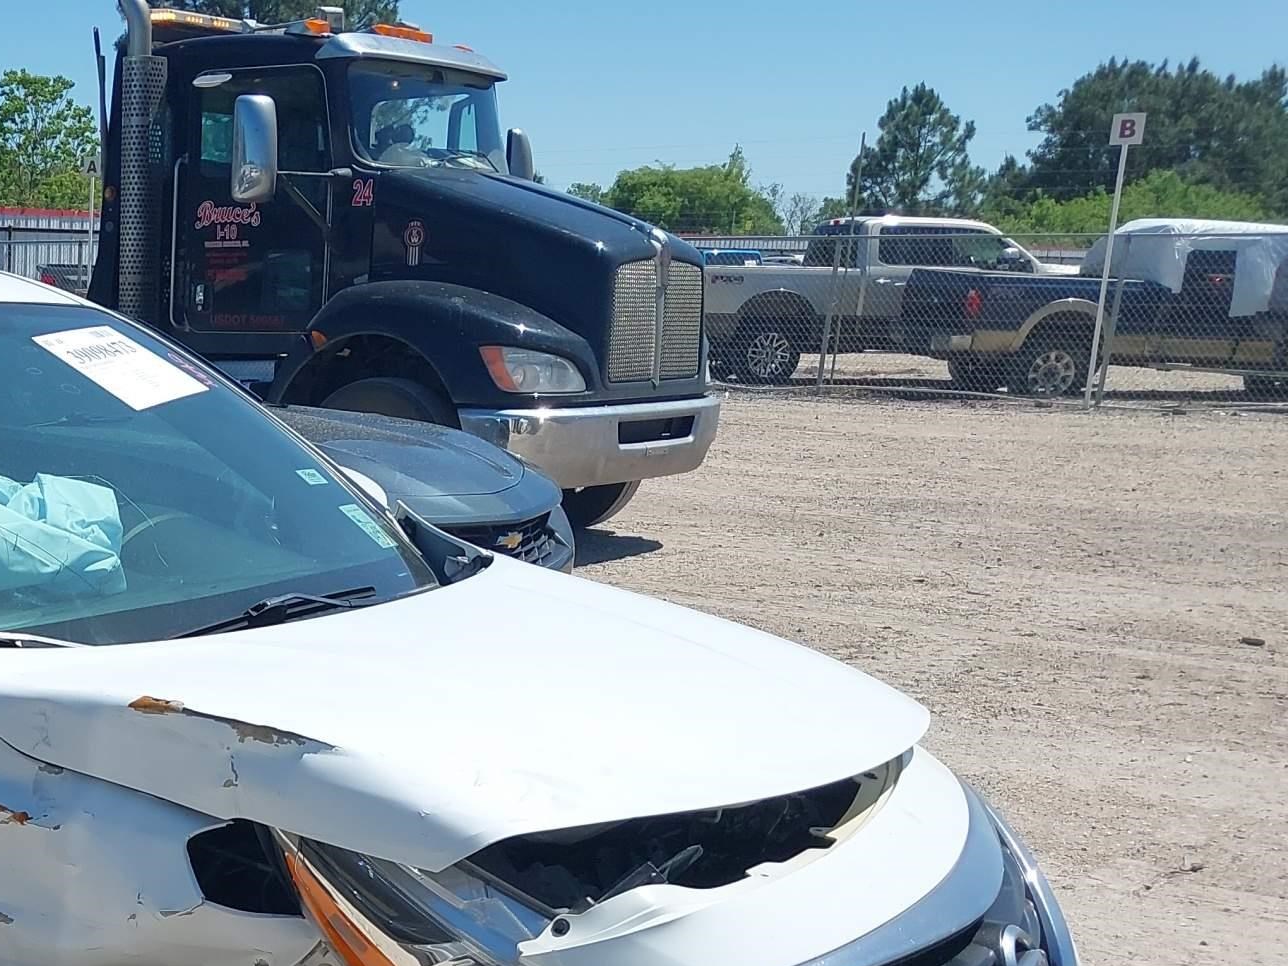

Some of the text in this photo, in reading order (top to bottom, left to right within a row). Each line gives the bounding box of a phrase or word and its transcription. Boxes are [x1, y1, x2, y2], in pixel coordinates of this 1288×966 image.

[1118, 119, 1136, 139] B
[86, 159, 97, 174] A
[351, 178, 374, 207] 24
[195, 200, 261, 230] Bruce's
[216, 223, 238, 240] I-10
